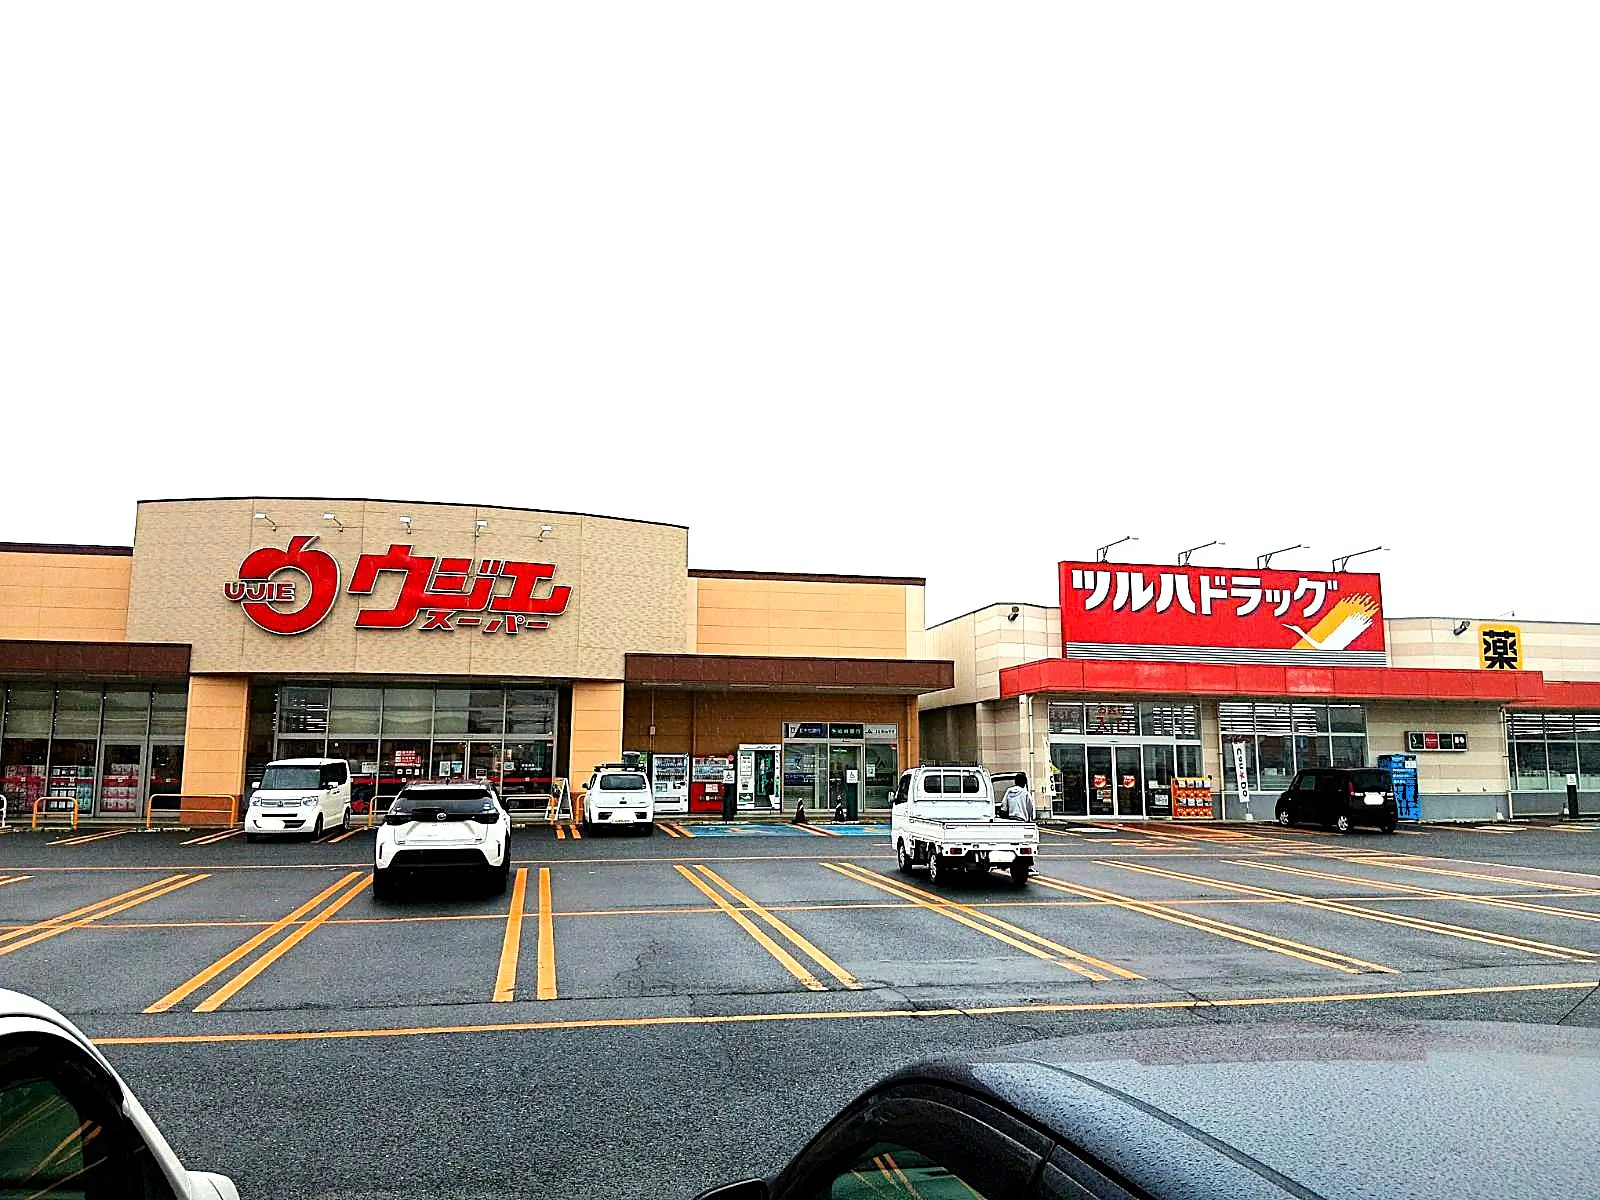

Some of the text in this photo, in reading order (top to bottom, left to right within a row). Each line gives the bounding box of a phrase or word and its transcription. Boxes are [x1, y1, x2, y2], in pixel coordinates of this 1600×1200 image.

[223, 581, 295, 601] UJIE
[347, 544, 573, 628] ウジエ
[1071, 569, 1338, 617] ツルハドラッグ
[418, 611, 549, 634] スーパー
[1482, 629, 1518, 669] 薬
